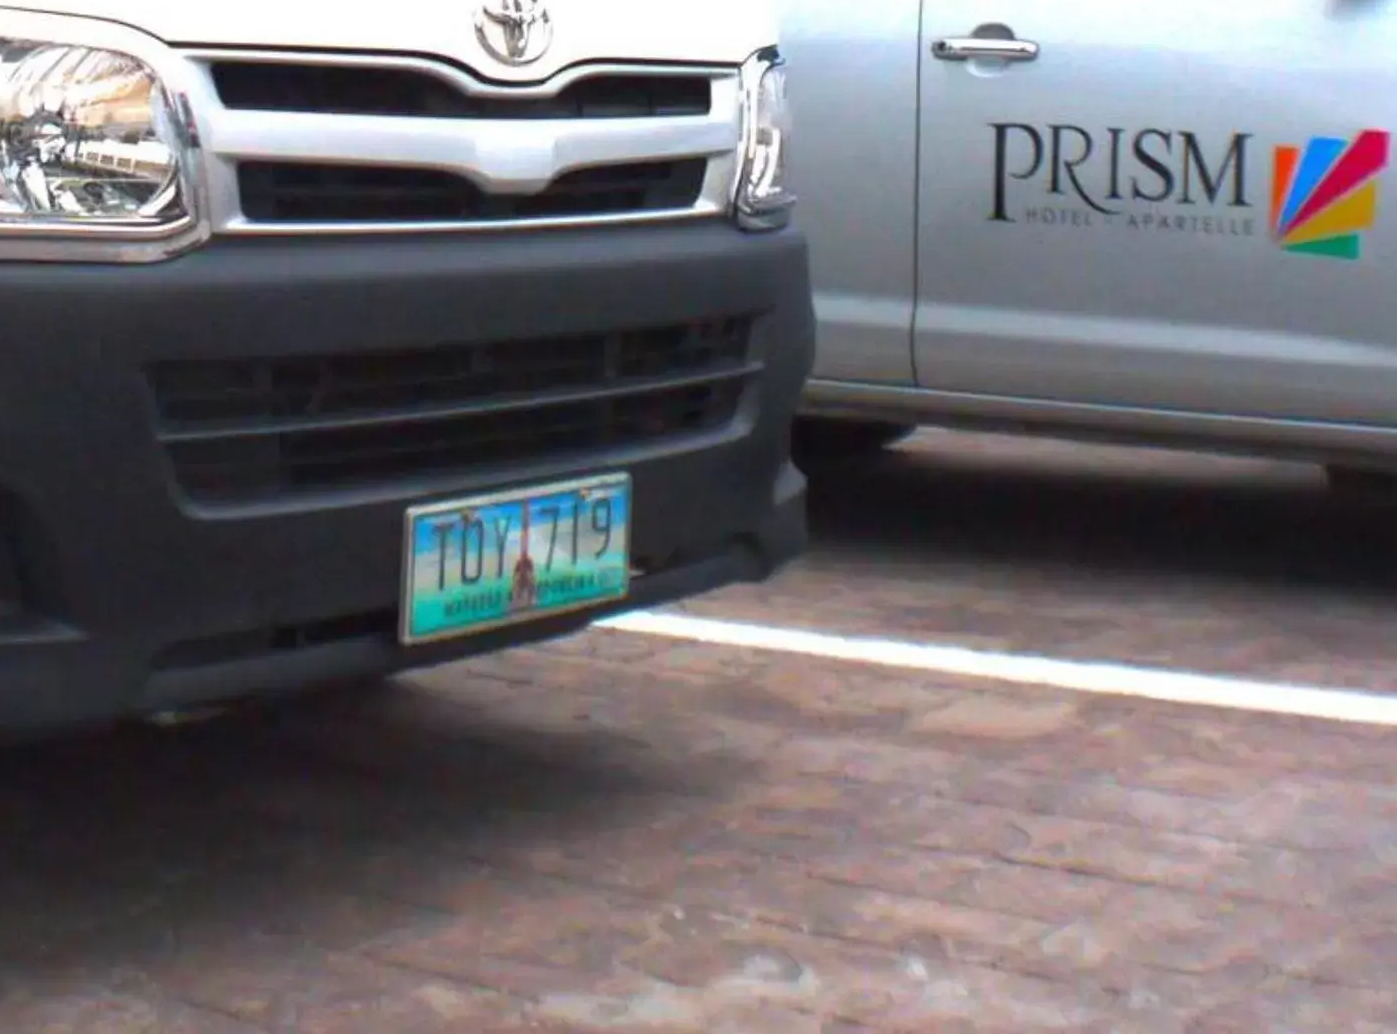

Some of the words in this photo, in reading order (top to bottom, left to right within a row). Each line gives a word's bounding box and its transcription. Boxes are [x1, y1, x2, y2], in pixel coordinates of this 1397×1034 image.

[987, 122, 1255, 224] PRISM
[1025, 206, 1093, 228] HOTEL
[1126, 213, 1256, 237] APARTELLE
[538, 497, 612, 575] 719
